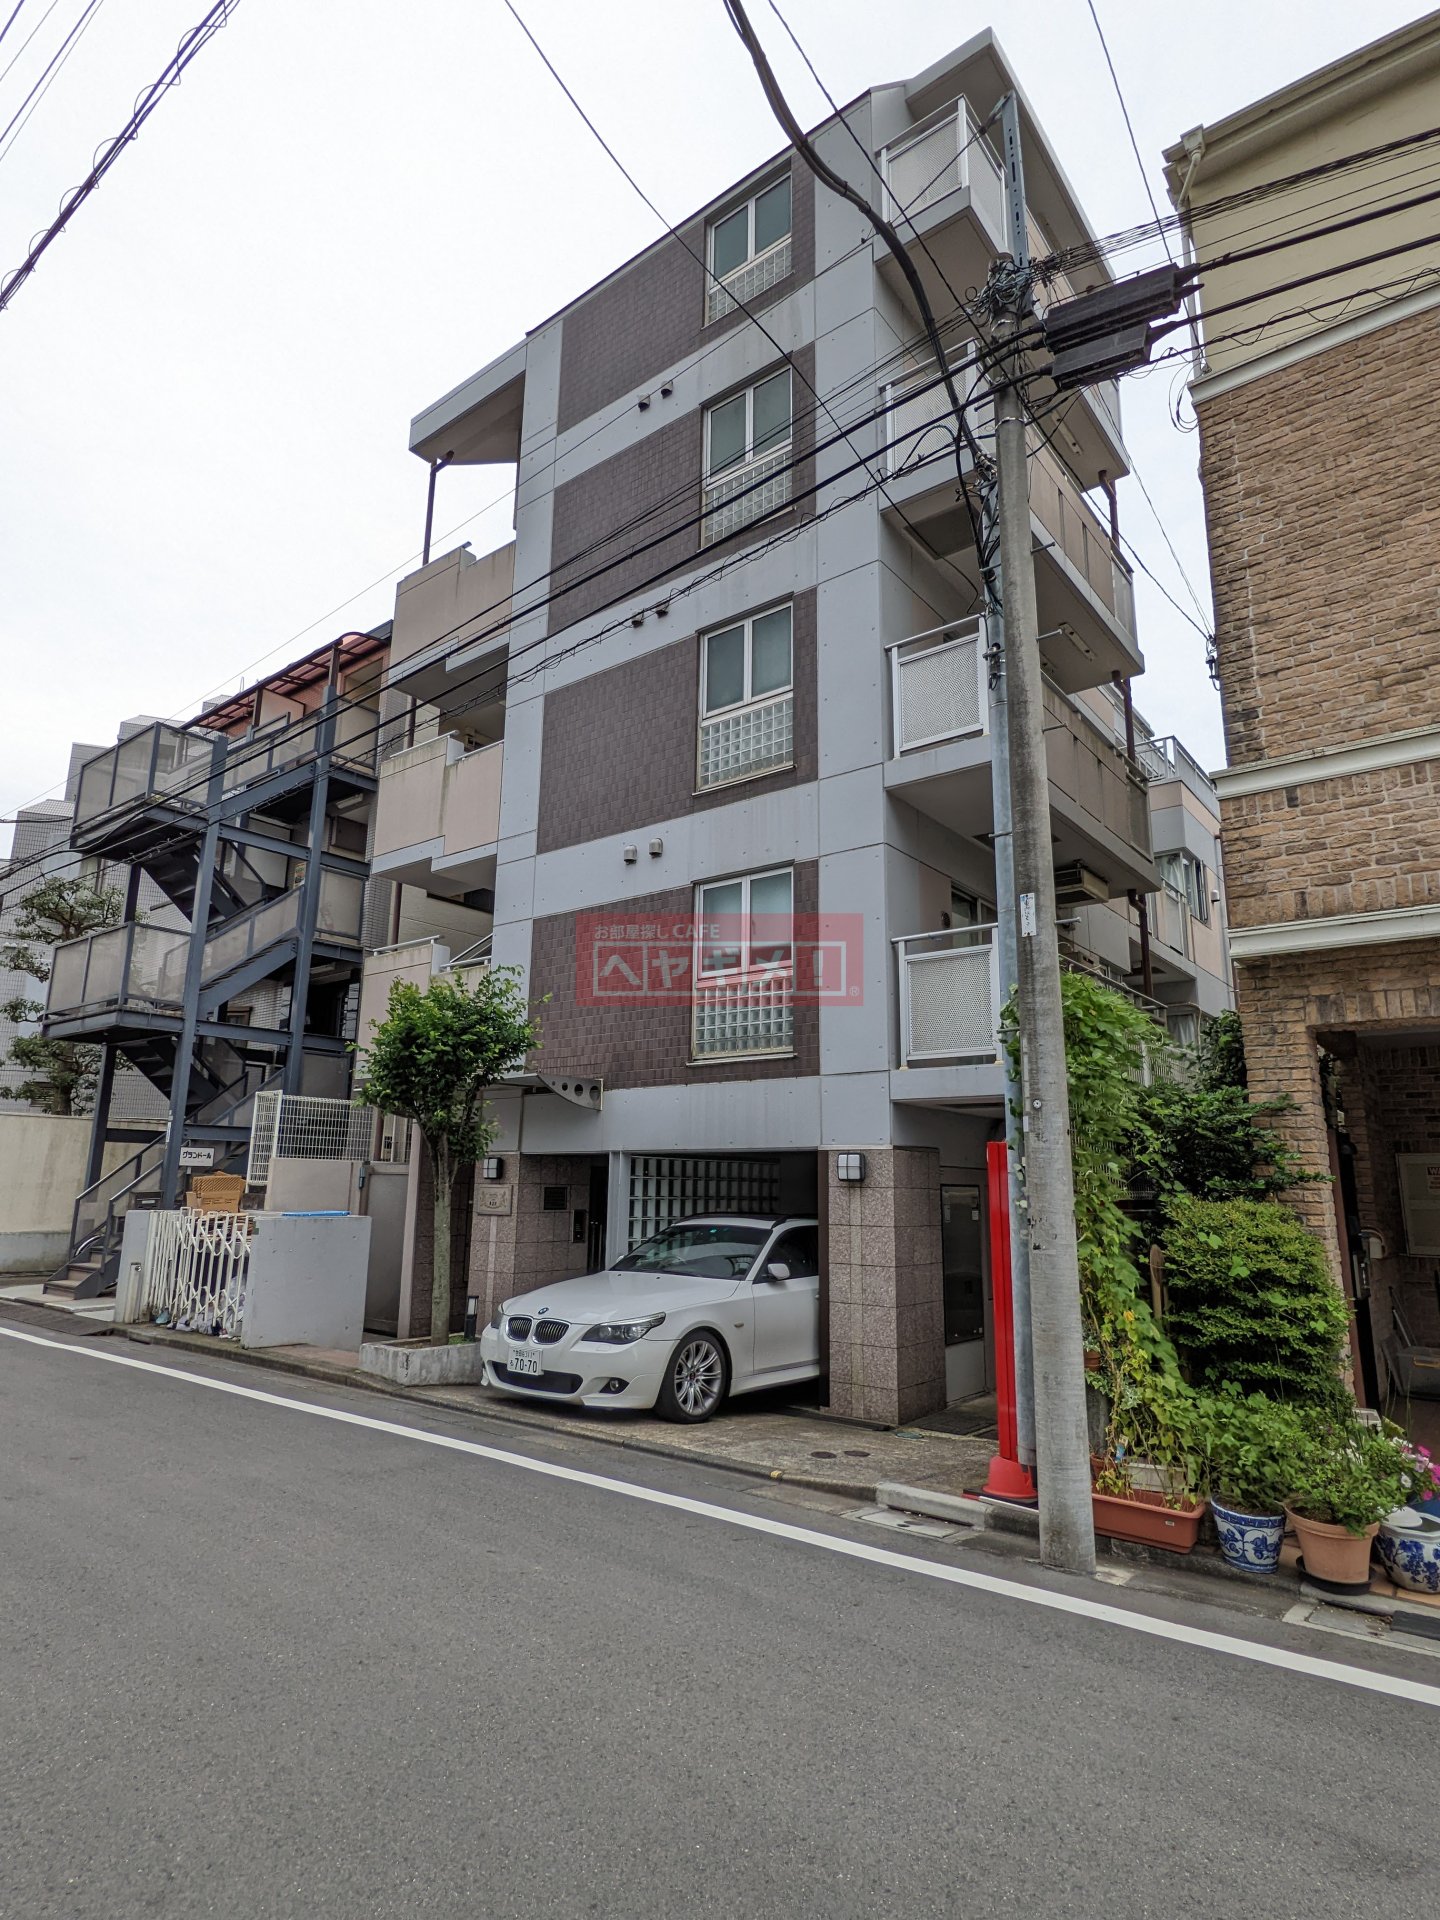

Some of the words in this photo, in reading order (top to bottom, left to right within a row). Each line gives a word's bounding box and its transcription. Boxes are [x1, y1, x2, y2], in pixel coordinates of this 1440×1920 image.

[182, 1151, 212, 1159] グランドール
[515, 1358, 537, 1373] 70-70
